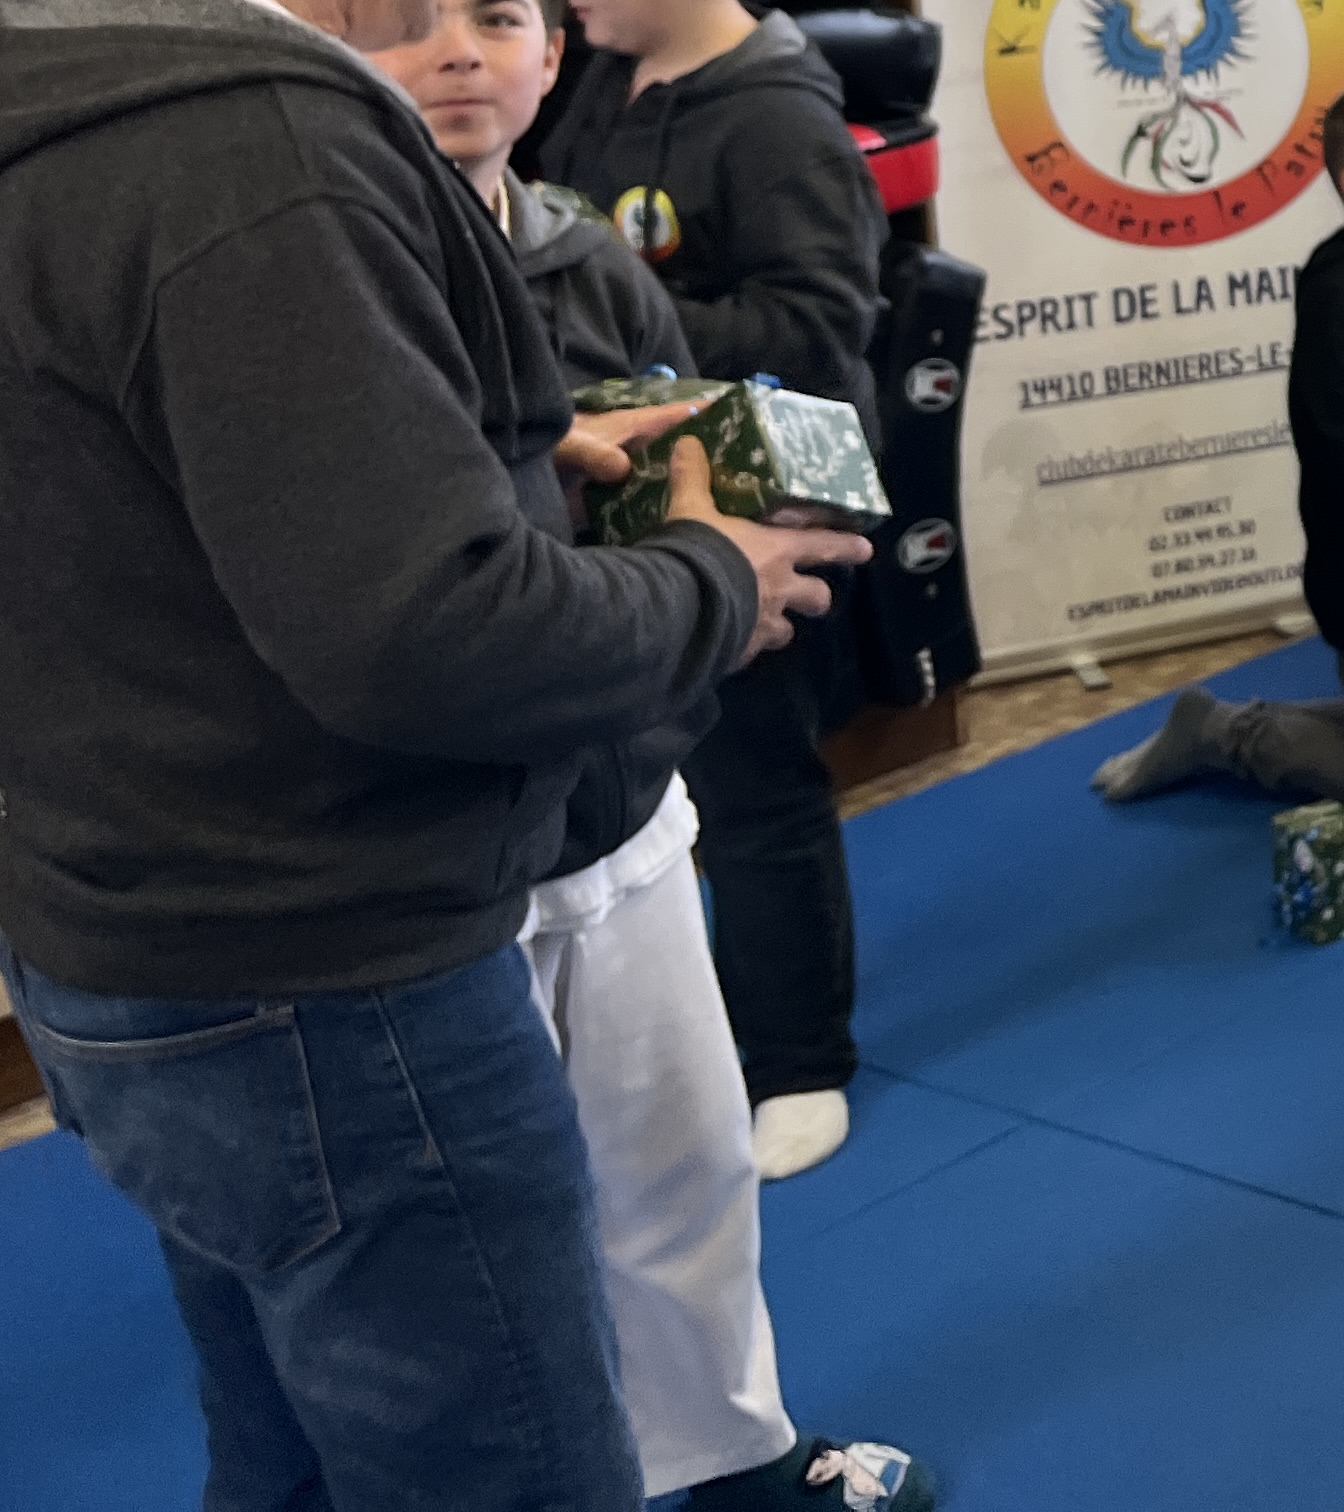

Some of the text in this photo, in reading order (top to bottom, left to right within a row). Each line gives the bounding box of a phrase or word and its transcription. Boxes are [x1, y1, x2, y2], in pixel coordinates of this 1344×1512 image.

[1112, 282, 1160, 324] DE
[1171, 274, 1216, 315] LA
[1227, 264, 1301, 307] MAI
[1019, 371, 1095, 406] 14410
